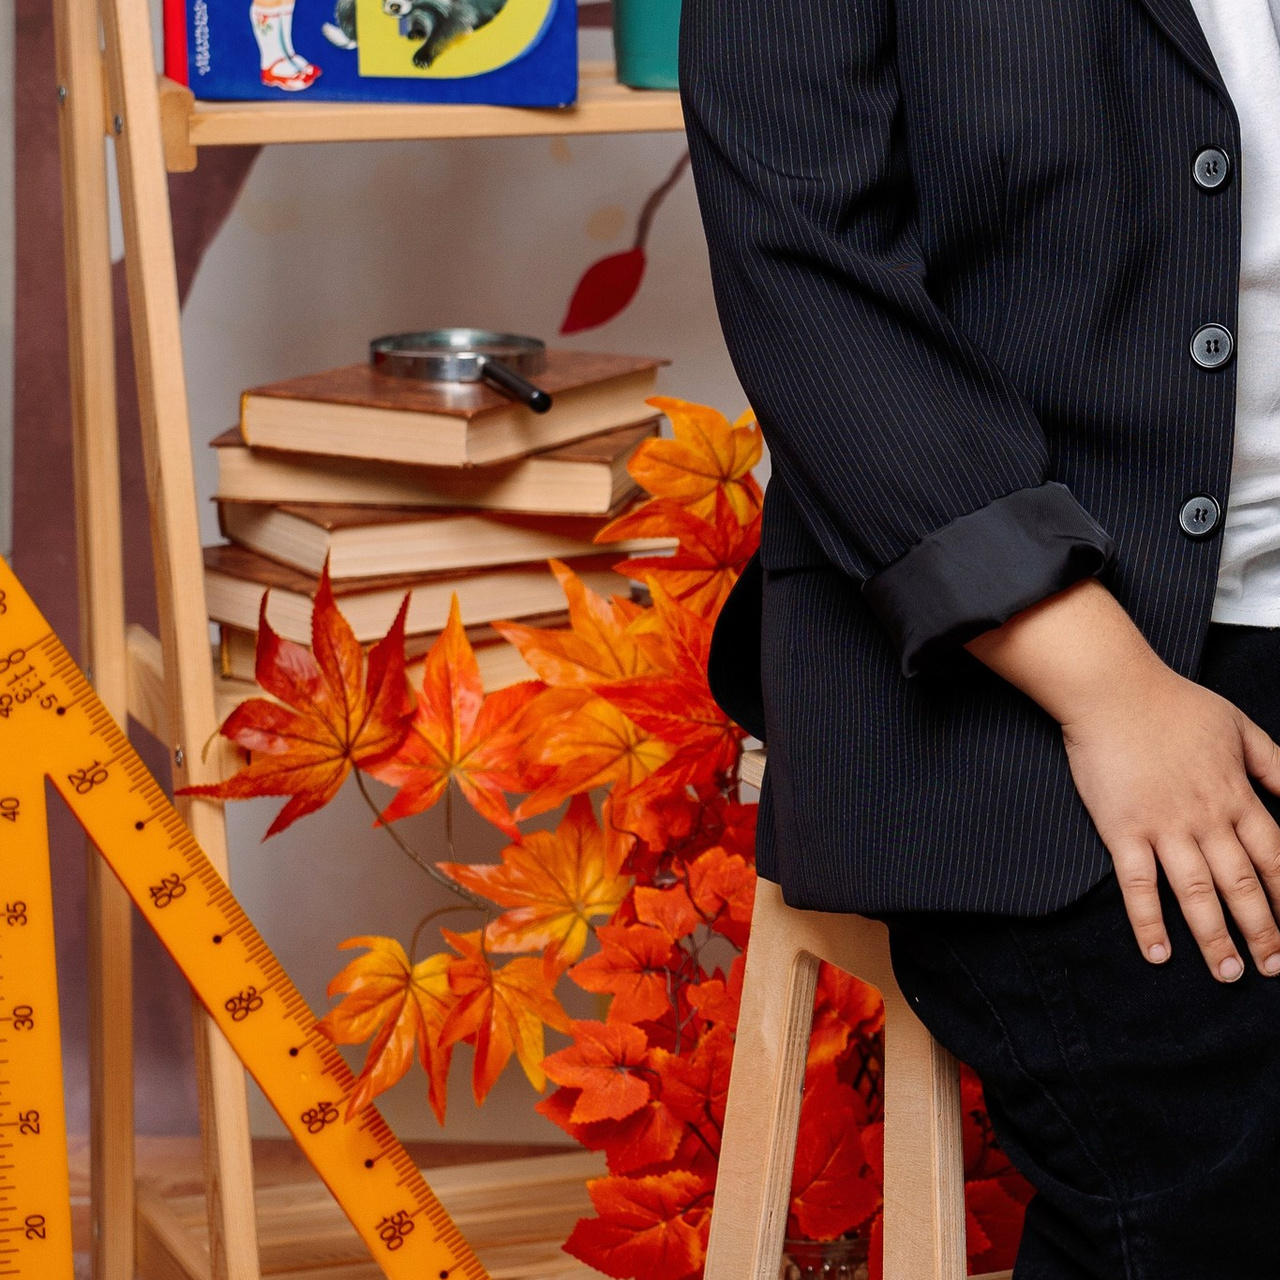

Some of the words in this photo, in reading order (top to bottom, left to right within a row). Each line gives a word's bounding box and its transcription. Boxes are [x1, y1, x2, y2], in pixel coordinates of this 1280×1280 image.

[68, 768, 94, 795] 20
[87, 760, 109, 786] 10
[0, 797, 20, 822] 40
[160, 873, 187, 899] 20
[7, 900, 28, 927] 35
[13, 1005, 35, 1031] 30
[19, 1109, 40, 1135] 25
[25, 1214, 46, 1240] 20
